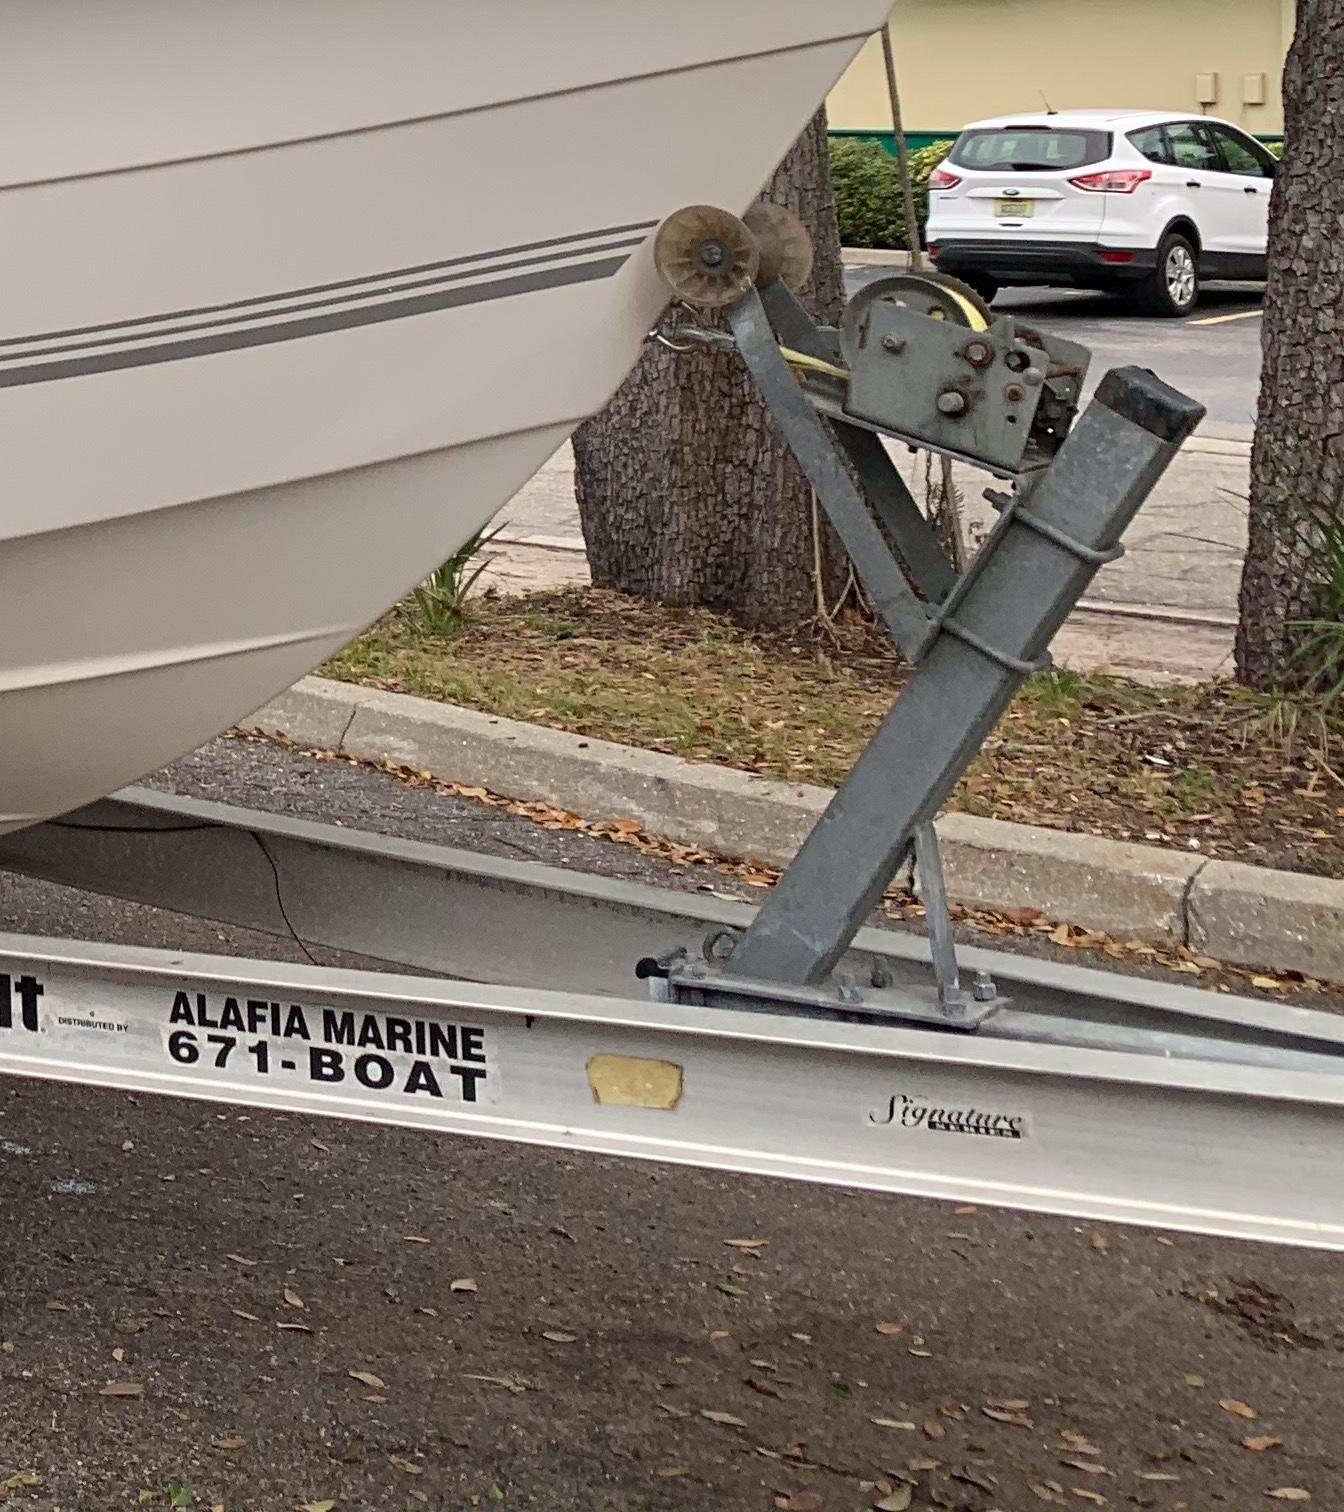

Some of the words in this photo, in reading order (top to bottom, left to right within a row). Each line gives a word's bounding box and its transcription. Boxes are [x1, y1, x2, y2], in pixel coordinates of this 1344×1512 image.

[58, 1016, 115, 1031] DISTRIBUTED
[116, 1023, 129, 1032] BY
[169, 991, 311, 1041] ALAFIA
[322, 1008, 487, 1064] MARINE
[168, 1030, 487, 1103] 671-BOAT
[869, 1094, 1022, 1130] Signature
